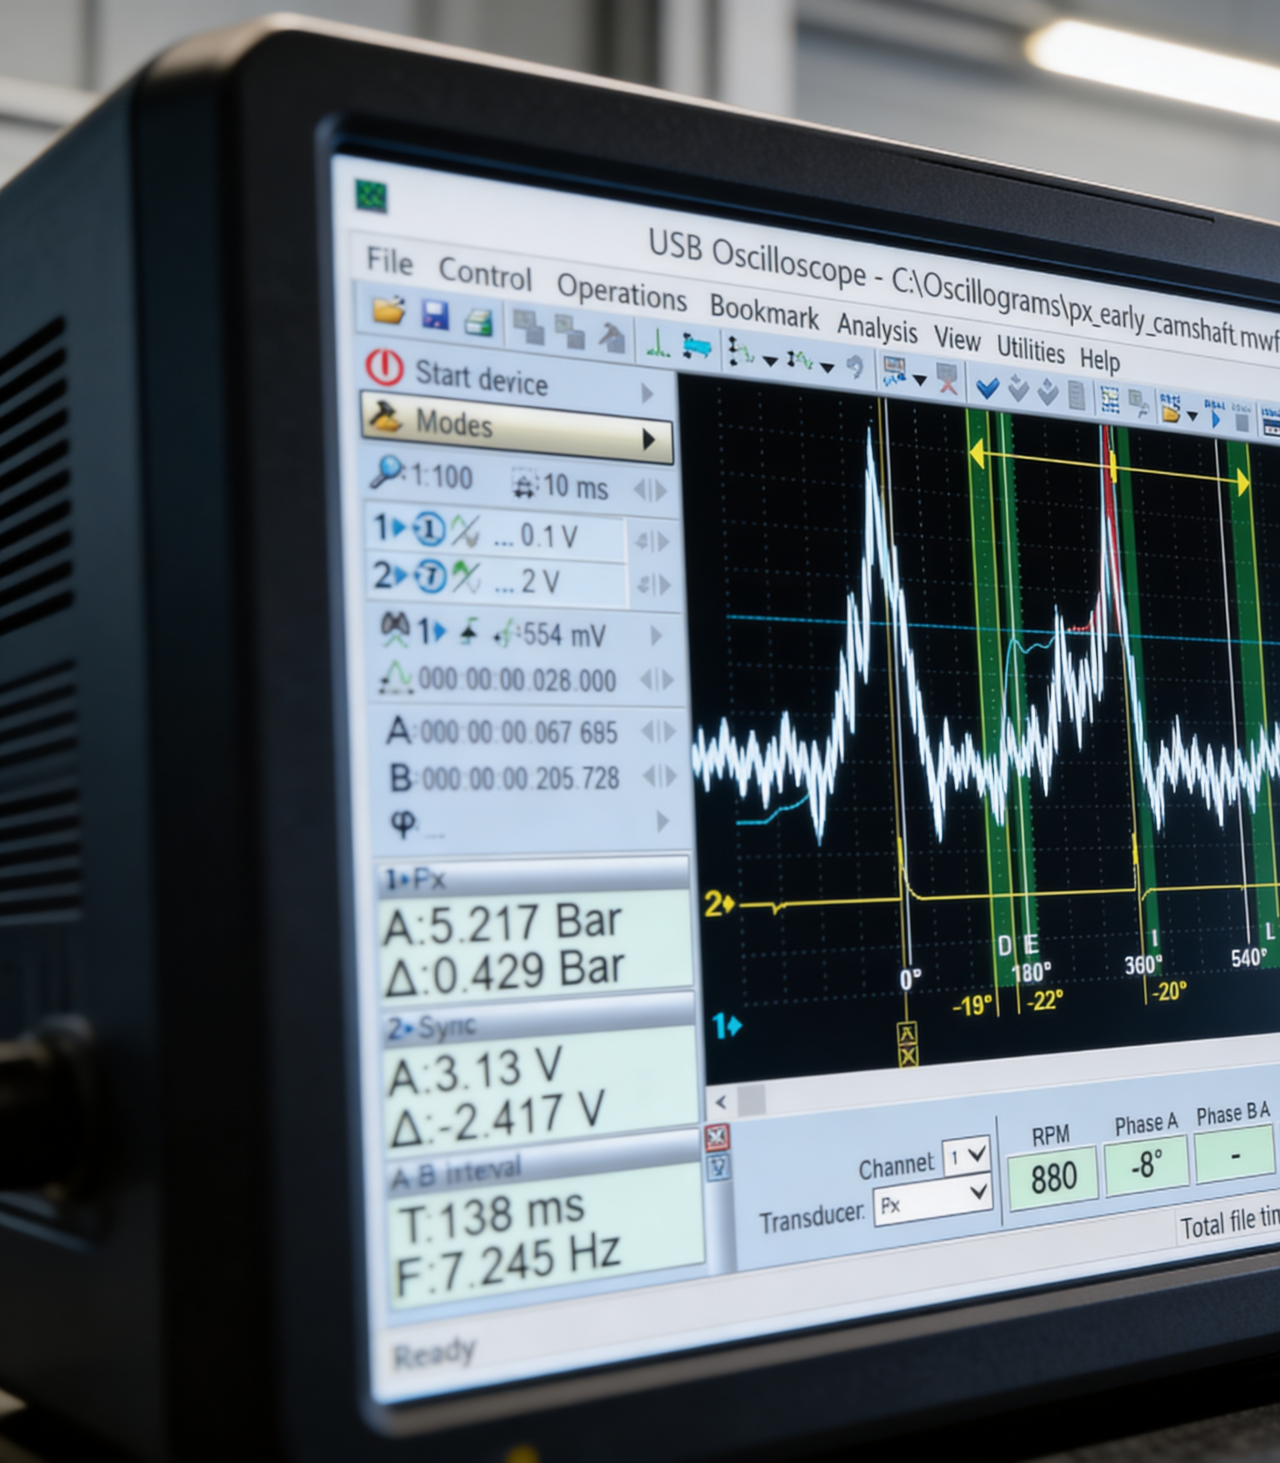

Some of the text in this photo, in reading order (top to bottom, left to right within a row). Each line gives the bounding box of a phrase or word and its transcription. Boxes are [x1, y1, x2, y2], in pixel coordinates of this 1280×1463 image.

[367, 245, 414, 276] File
[648, 227, 703, 262] USB
[711, 238, 867, 291] Oscilloscope
[439, 256, 532, 292] Control
[557, 272, 688, 312] Operations
[710, 293, 820, 331] Bookmark
[837, 312, 919, 346] Analysis
[934, 325, 982, 353] View
[997, 334, 1067, 365] Utilities
[1080, 347, 1121, 377] Help
[416, 359, 549, 397] Start device
[417, 407, 494, 438] Modes
[577, 479, 609, 501] ms
[521, 521, 578, 549] 0.1 V
[373, 560, 393, 589] 2
[521, 568, 560, 594] 2 V
[571, 624, 606, 648] mV
[704, 890, 724, 918] 2
[383, 902, 624, 947] A:5.217 Bar
[1265, 921, 1277, 941] L
[997, 933, 1013, 957] D
[1023, 933, 1040, 956] E
[1230, 947, 1269, 969] 540°
[385, 949, 626, 998] Δ:0.429 Bar
[899, 967, 923, 992] 0°
[1011, 960, 1053, 984] 180°
[1124, 953, 1164, 977] 360°
[952, 993, 994, 1017] -19°
[1026, 988, 1065, 1012] -22°
[1151, 979, 1188, 1002] -20°
[419, 1014, 478, 1044] Sync
[711, 1011, 726, 1040] 1
[387, 1044, 564, 1098] A:3.13 V
[578, 1087, 606, 1128] V
[1196, 1105, 1243, 1127] Phase
[1032, 1123, 1071, 1148] RPM
[1115, 1111, 1179, 1137] Phase A
[1031, 1159, 1079, 1195] 880
[1131, 1148, 1163, 1179] -8°
[399, 1192, 586, 1245] T:138 ms
[1180, 1211, 1225, 1240] Total
[1230, 1207, 1257, 1233] file
[396, 1231, 622, 1298] F:7.245 Hz
[393, 1336, 477, 1373] Ready
